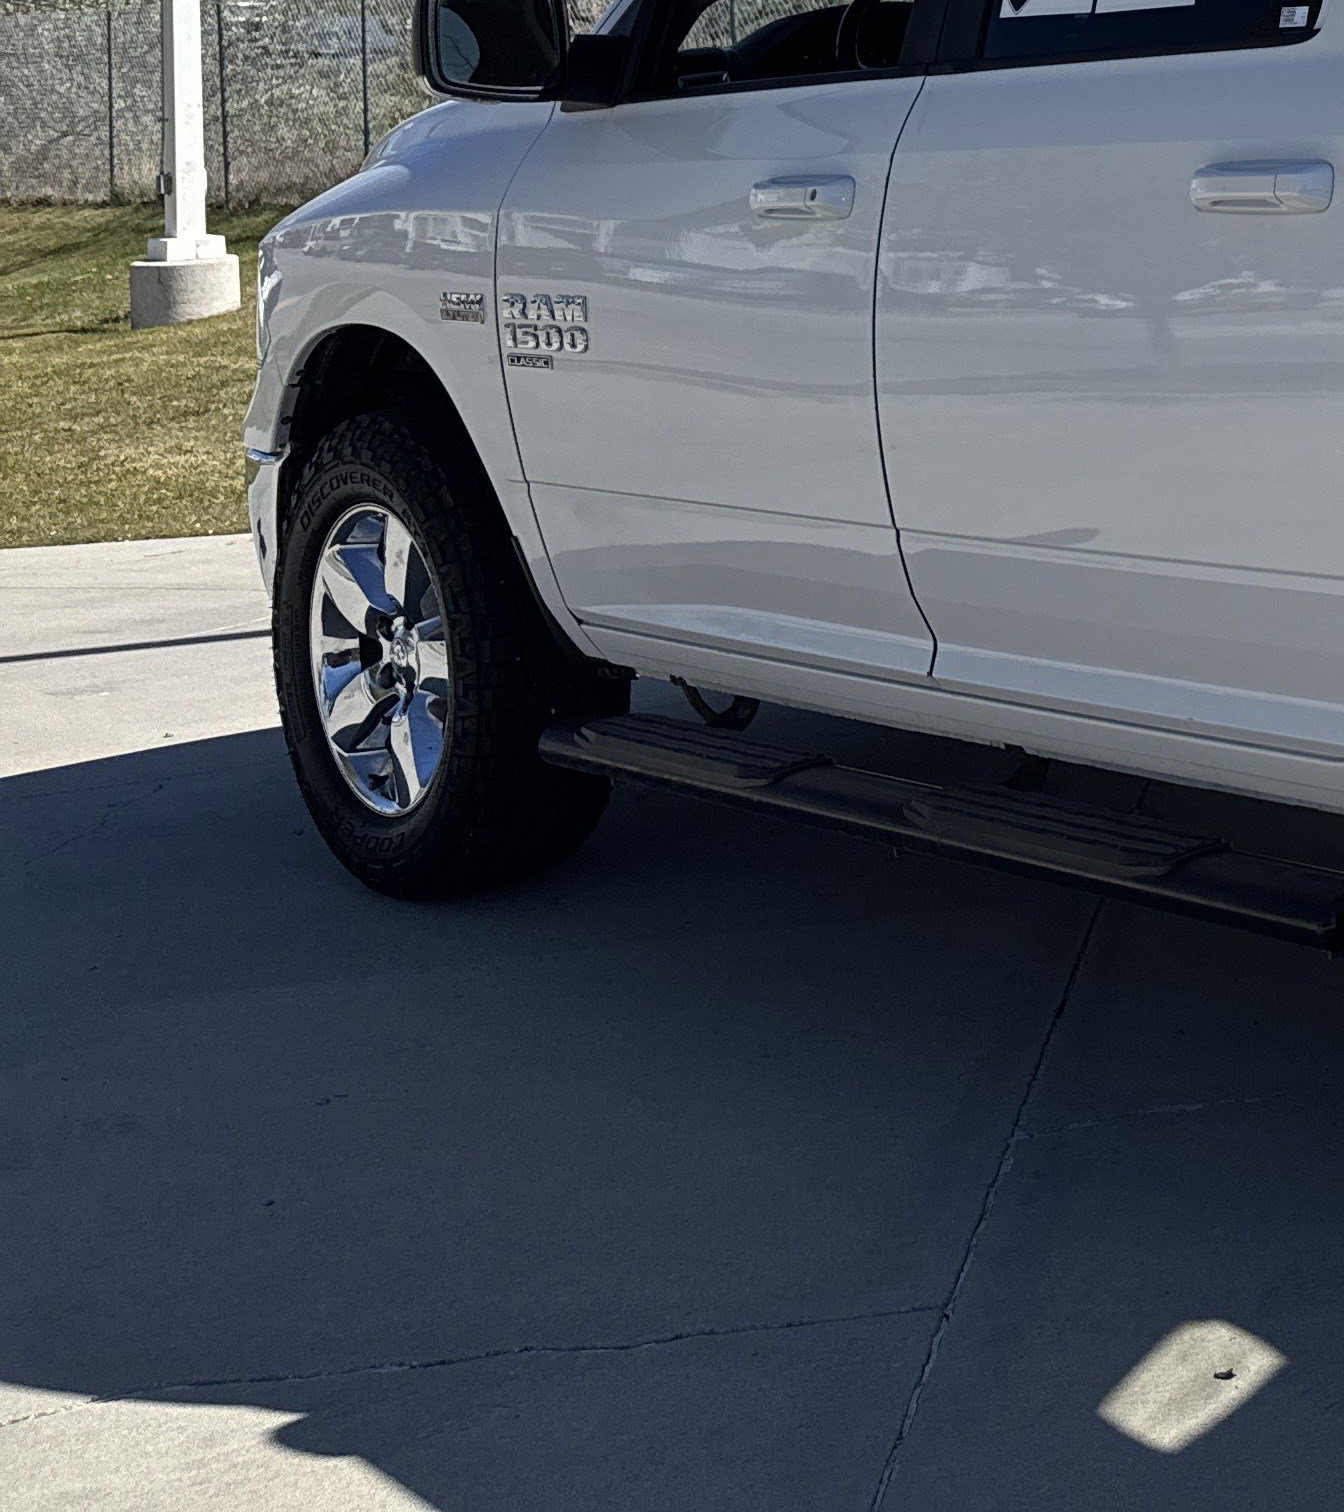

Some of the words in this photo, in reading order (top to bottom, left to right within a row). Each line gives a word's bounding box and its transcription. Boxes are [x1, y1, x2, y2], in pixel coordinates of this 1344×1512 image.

[502, 293, 588, 322] RAM
[504, 323, 589, 353] 1500
[508, 355, 550, 369] CLASSIC
[299, 470, 395, 531] DISCOVERER
